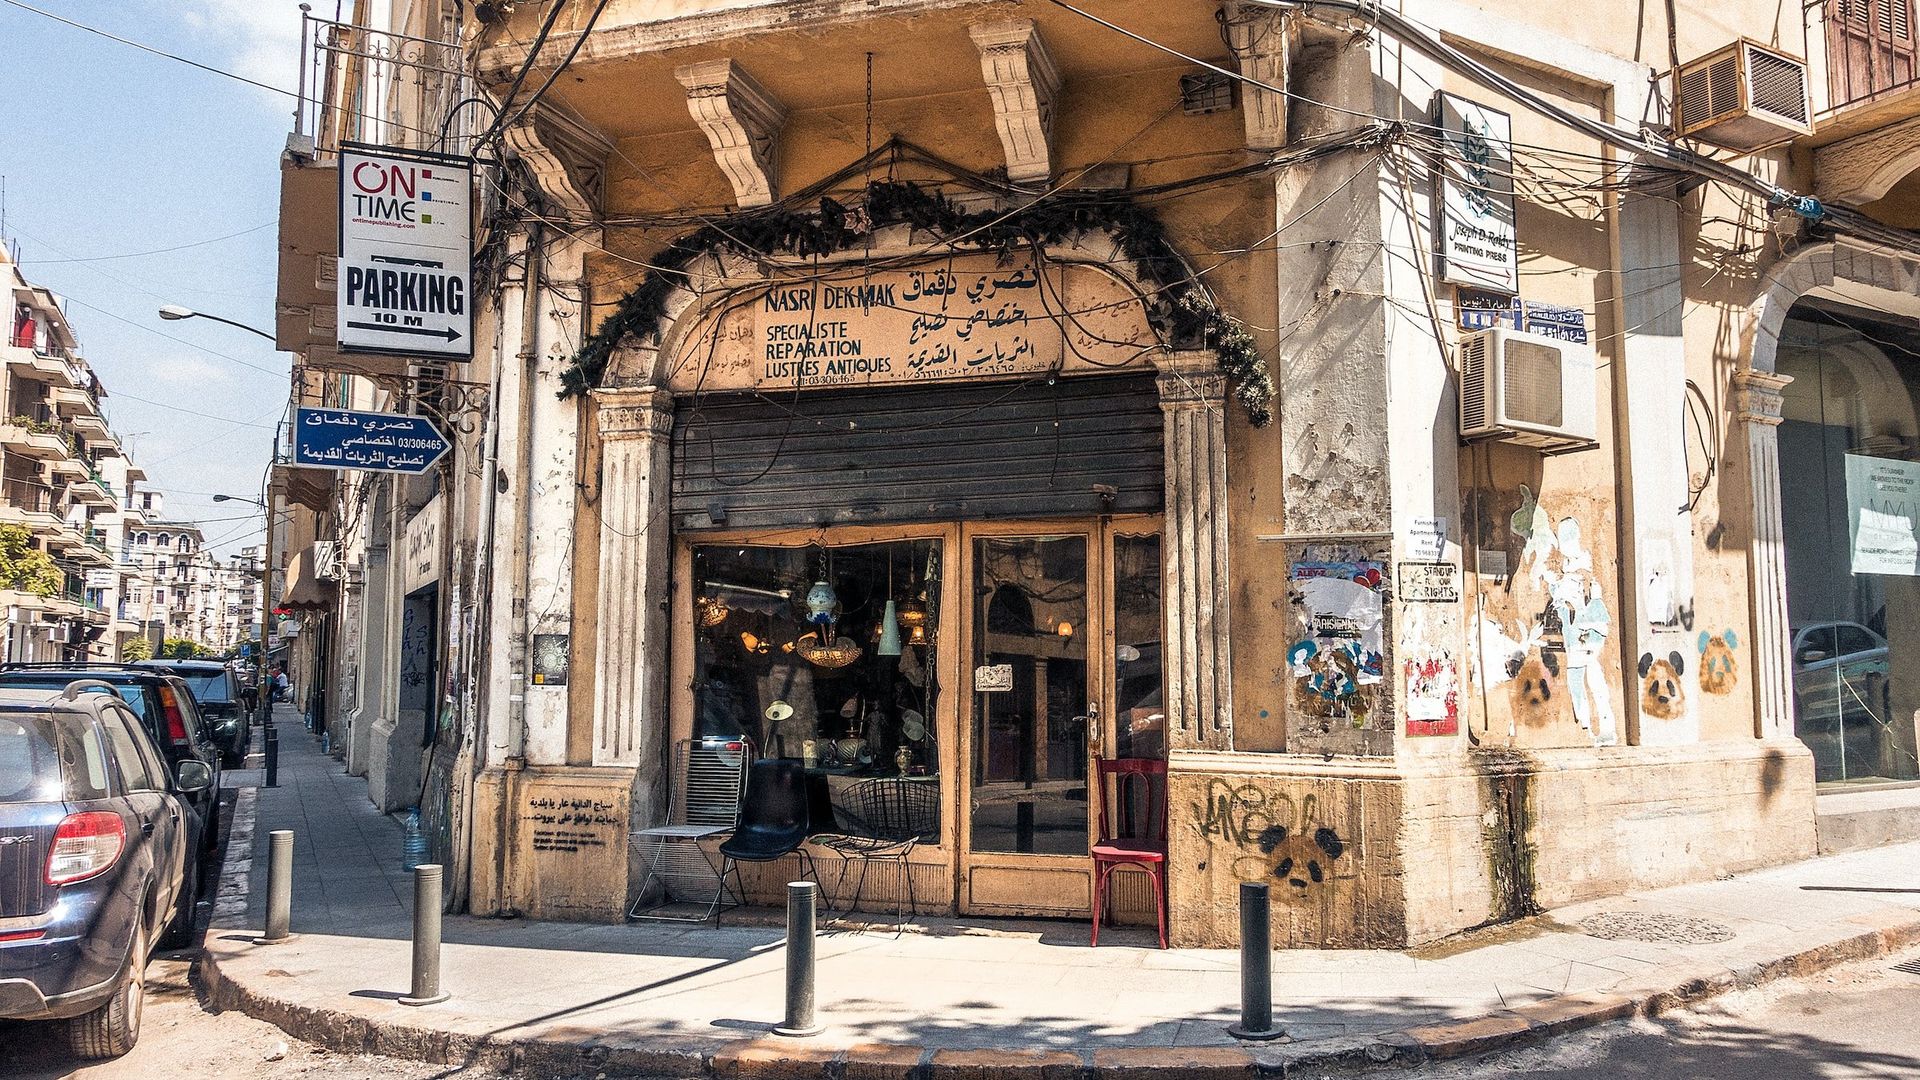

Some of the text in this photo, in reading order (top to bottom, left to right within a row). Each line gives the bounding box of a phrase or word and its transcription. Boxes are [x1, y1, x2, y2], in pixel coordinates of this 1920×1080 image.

[352, 161, 416, 199] ON
[352, 194, 416, 222] TIME
[352, 217, 416, 229] ontimepublishing.com
[1454, 242, 1507, 263] PRINTING PRESS
[346, 266, 464, 316] PARKING
[902, 263, 1038, 304] نصري دقماق
[765, 283, 896, 313] NASRI DEKMAK
[371, 312, 423, 327] 10 M
[909, 302, 1028, 345] اختصاصي تصليح
[767, 321, 848, 342] SPECIALISTE
[766, 339, 862, 360] REPARATION
[907, 335, 1035, 371] الثريات القديمة
[765, 357, 892, 379] LUSTRES ANTIQUES
[305, 412, 414, 432] نصري دقماق
[341, 435, 442, 450] 03/306465 اختصاصي
[303, 444, 424, 468] تصليح الثريات القديمة
[1424, 586, 1454, 598] RIGHTS
